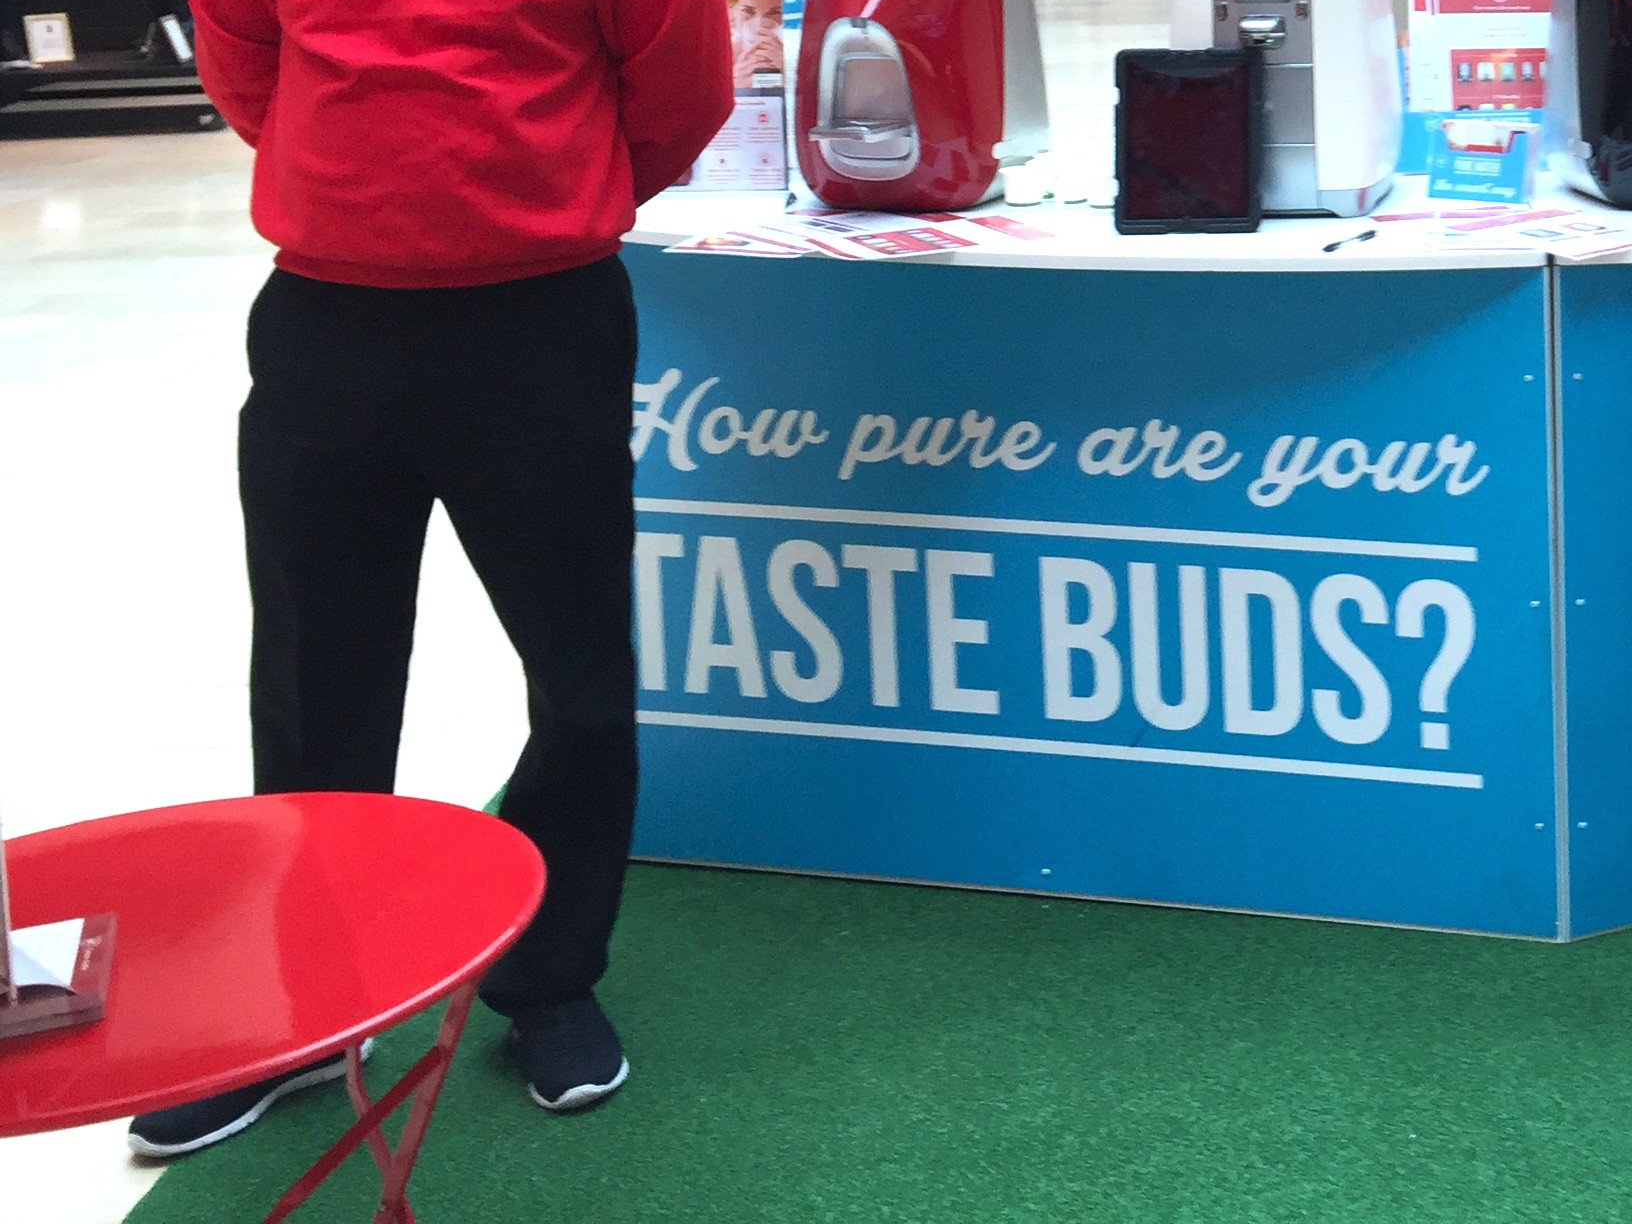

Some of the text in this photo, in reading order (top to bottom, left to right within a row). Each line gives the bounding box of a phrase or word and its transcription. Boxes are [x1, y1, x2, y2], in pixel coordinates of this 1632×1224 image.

[632, 369, 1489, 507] How pure are your
[634, 532, 1475, 750] TASTE BUDS?
